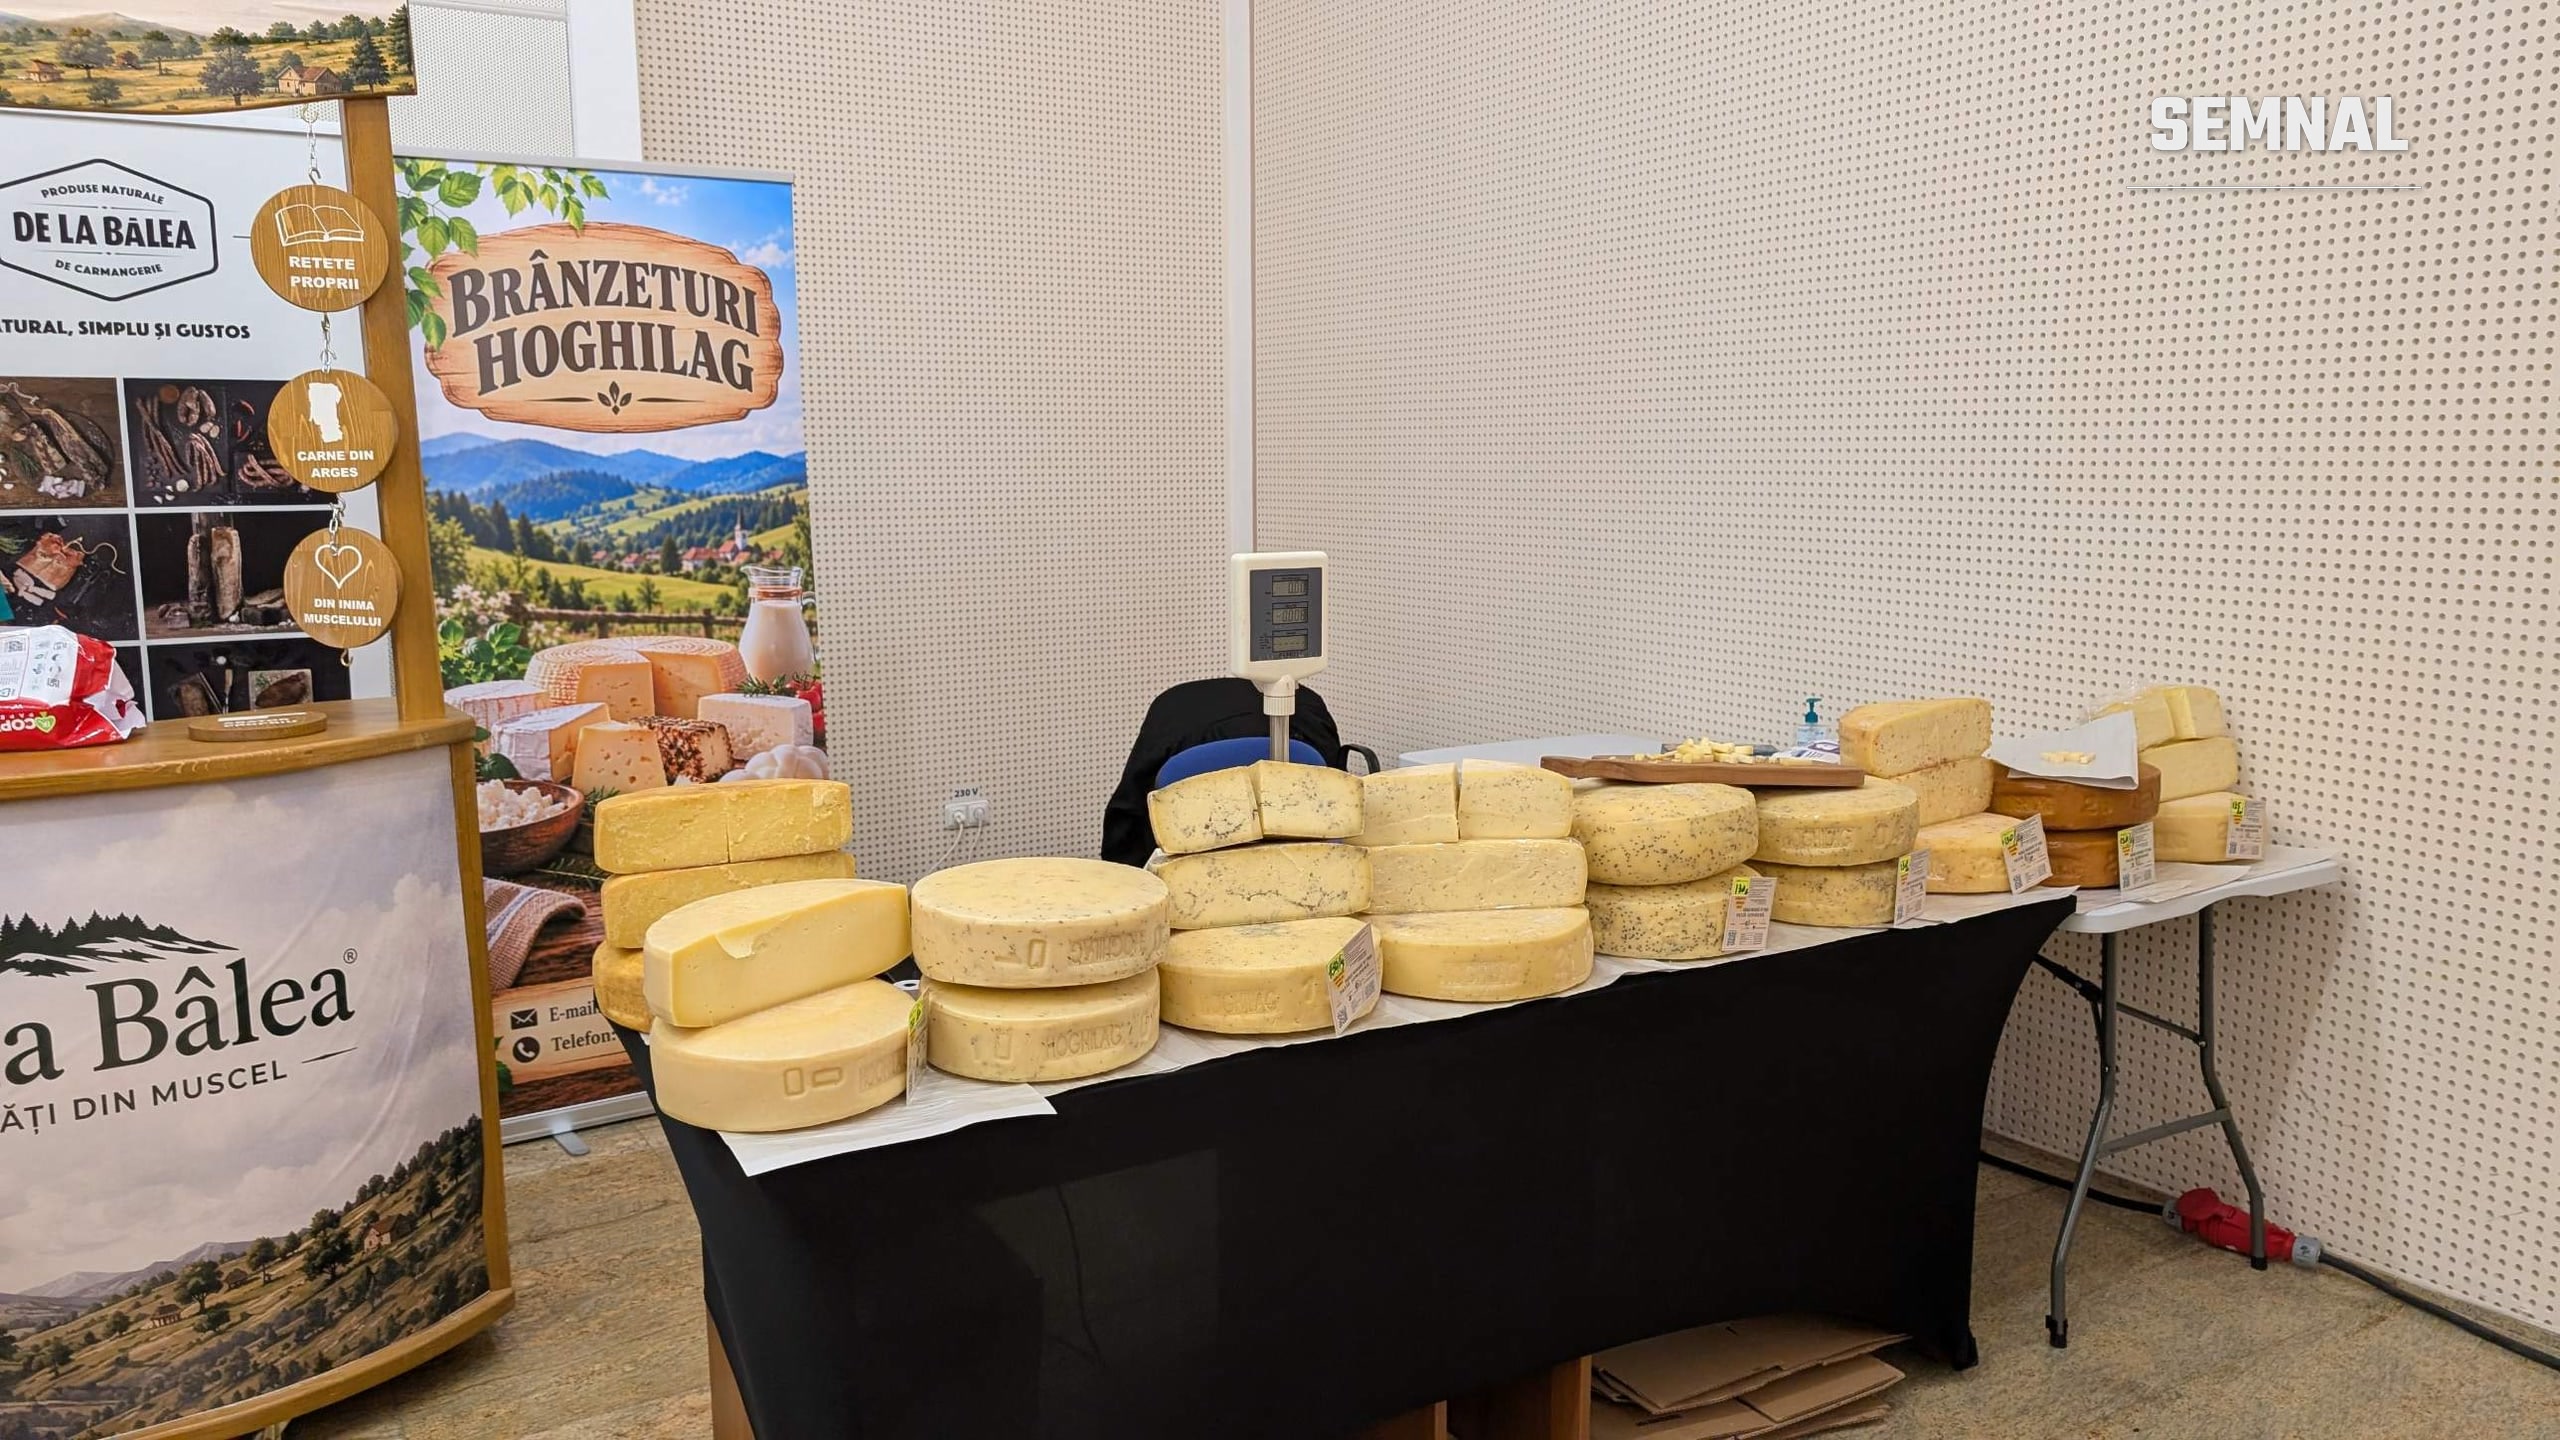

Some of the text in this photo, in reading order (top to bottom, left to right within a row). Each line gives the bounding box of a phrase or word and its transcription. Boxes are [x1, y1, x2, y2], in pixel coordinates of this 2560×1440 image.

[41, 184, 165, 204] PRODUSE NATURALE
[13, 211, 51, 243] DE
[58, 213, 97, 245] LA
[55, 259, 164, 277] DE CARMANGERIE
[289, 255, 355, 270] RETETE
[290, 275, 360, 290] PROPRII
[447, 249, 761, 340] BRÂNZETURI
[78, 320, 149, 337] SIMPLU
[176, 323, 251, 339] GUSTOS
[473, 319, 755, 397] HOGHILAG
[297, 450, 375, 462] CARNE DIN
[311, 467, 359, 478] ARGES
[314, 598, 375, 611] DIN INIMA
[304, 613, 382, 627] MUSCELULUI
[0, 717, 36, 733] COP
[954, 787, 979, 798] 230 V
[0, 1021, 65, 1087] a
[86, 957, 356, 1072] Bâlea
[551, 1030, 617, 1052] Telefon:
[73, 1088, 137, 1120] DIN
[151, 1060, 288, 1107] MUSCEL
